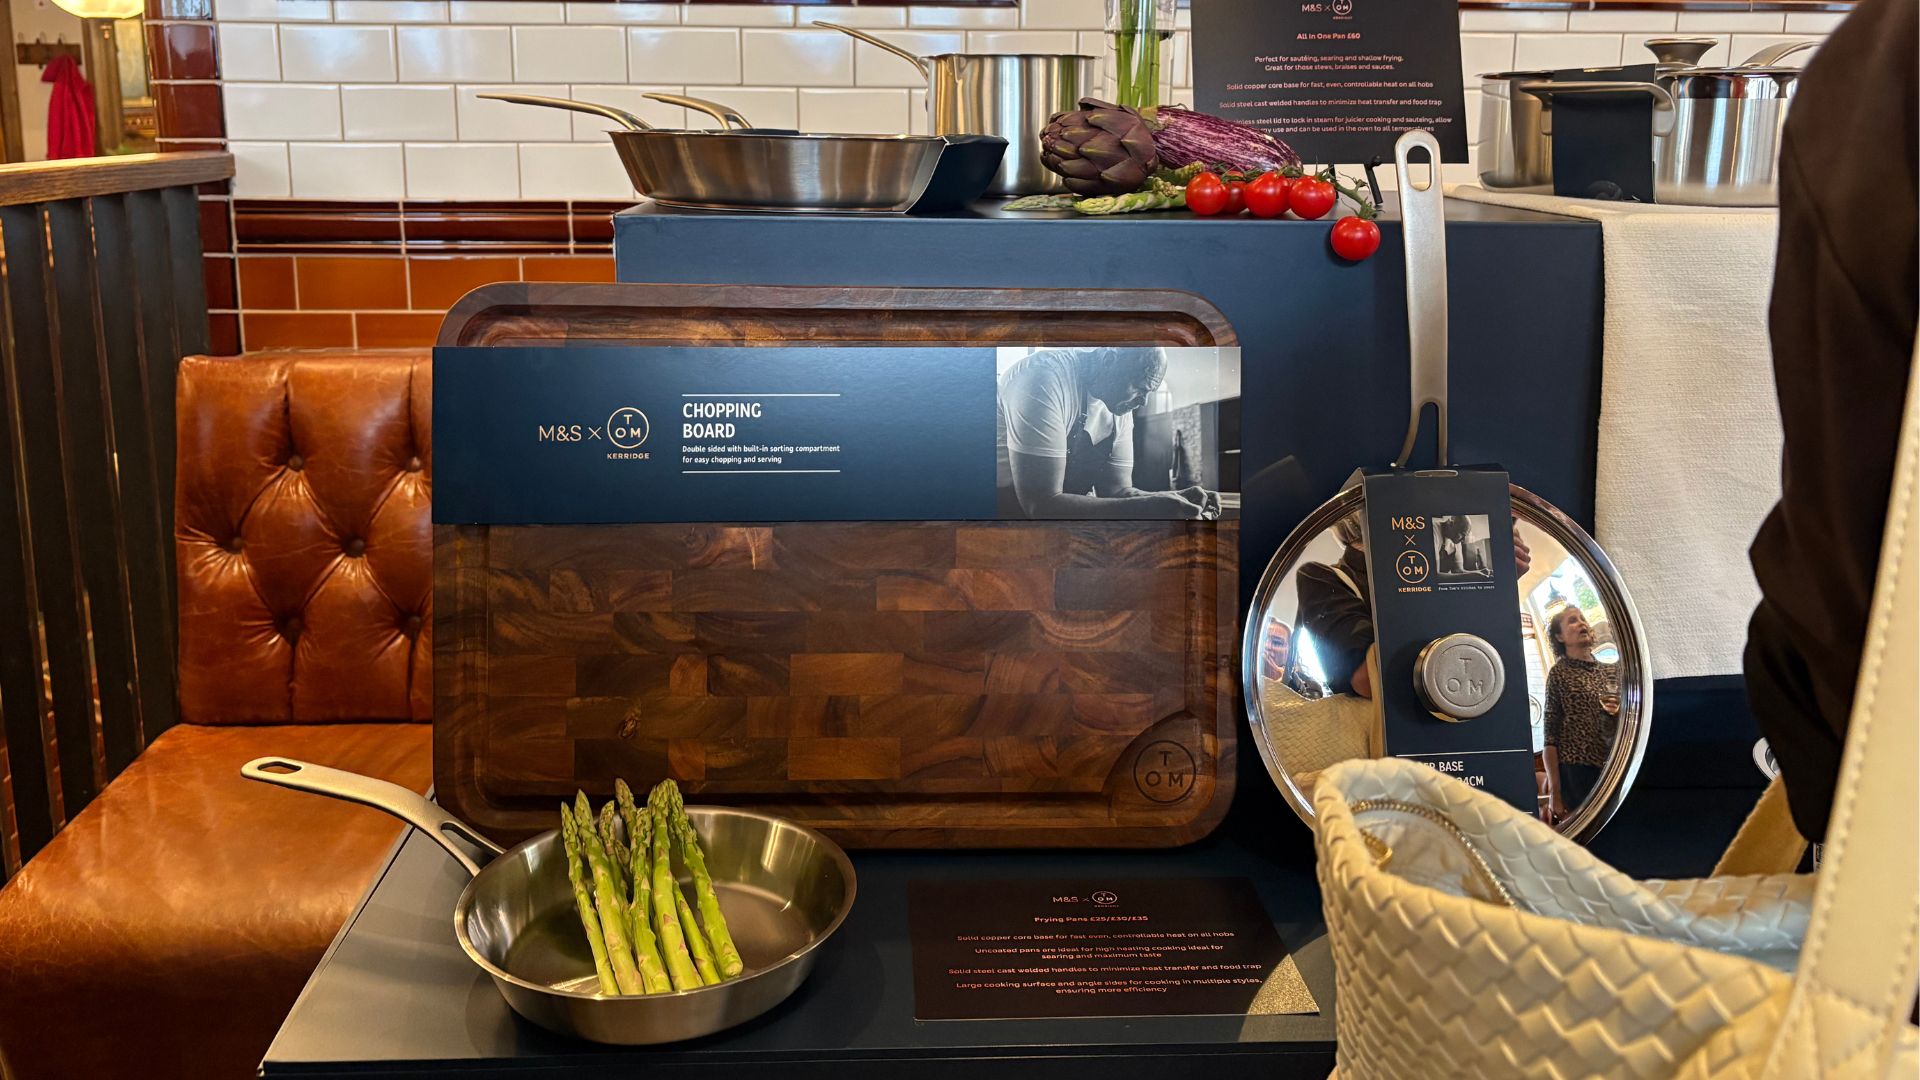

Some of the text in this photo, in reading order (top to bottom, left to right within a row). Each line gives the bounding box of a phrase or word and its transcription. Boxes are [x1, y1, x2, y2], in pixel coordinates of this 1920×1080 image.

[682, 403, 762, 418] CHOPPING
[539, 425, 582, 442] M&S
[682, 424, 736, 438] BOARD
[770, 445, 793, 454] sorting
[796, 445, 840, 454] compartment
[711, 456, 742, 464] chopping
[758, 456, 782, 464] serving
[1392, 516, 1425, 530] M&S
[1439, 761, 1464, 772] BASE
